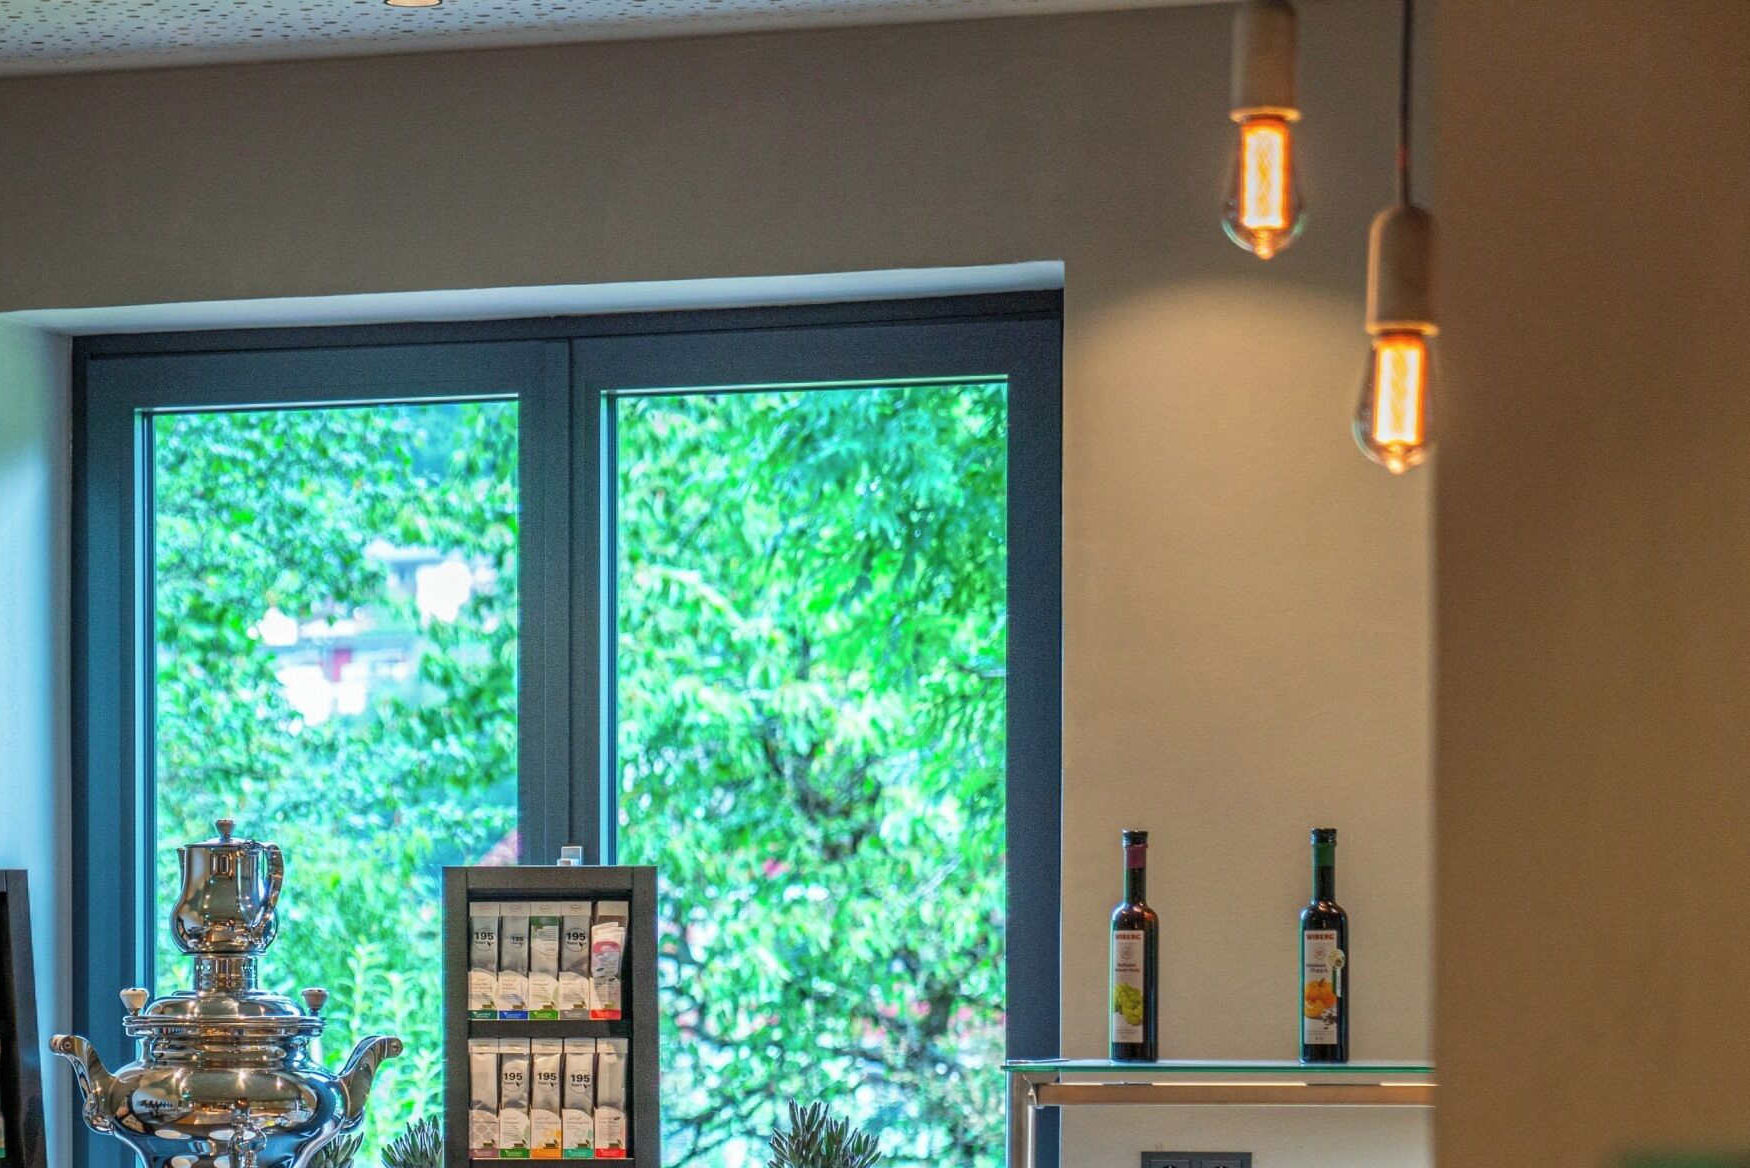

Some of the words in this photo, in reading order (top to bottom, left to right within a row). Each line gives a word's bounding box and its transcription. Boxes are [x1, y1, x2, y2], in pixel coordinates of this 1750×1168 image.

[474, 932, 494, 940] 195
[567, 932, 586, 941] 195
[504, 1072, 523, 1081] 195
[538, 1072, 557, 1081] 195
[571, 1074, 590, 1083] 195
